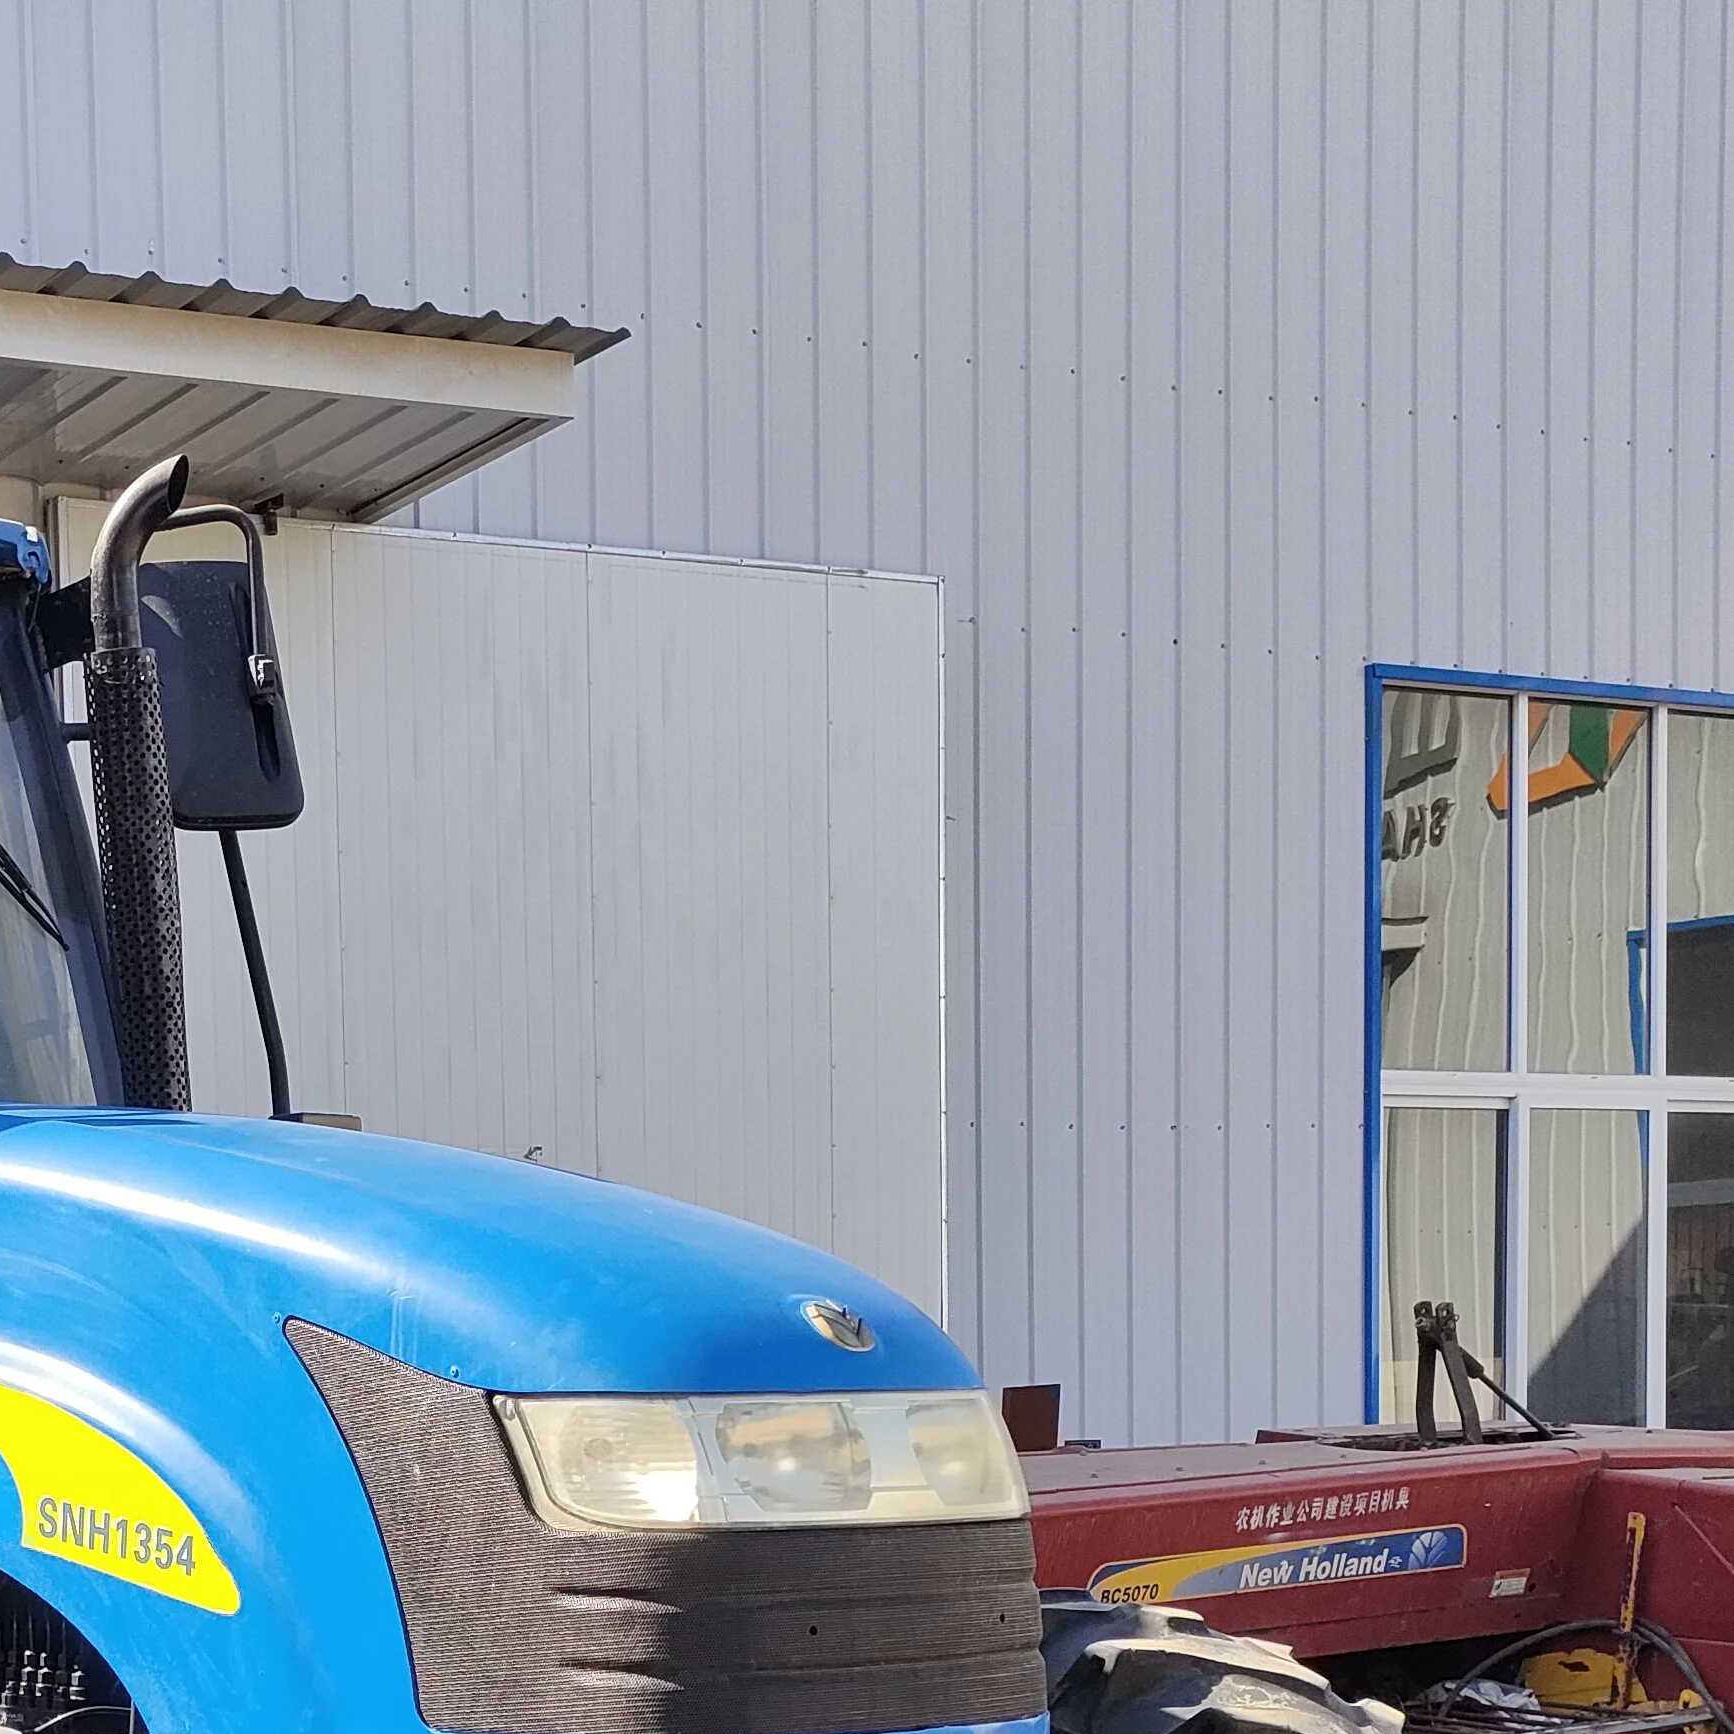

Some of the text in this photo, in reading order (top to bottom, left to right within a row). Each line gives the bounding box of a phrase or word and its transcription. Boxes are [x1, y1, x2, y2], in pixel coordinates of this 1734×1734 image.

[1235, 1486, 1411, 1533] 农机作业公司建设项目机具
[39, 1497, 196, 1577] SNH1354
[1238, 1548, 1390, 1589] New Holland
[1100, 1583, 1160, 1604] BC5070
